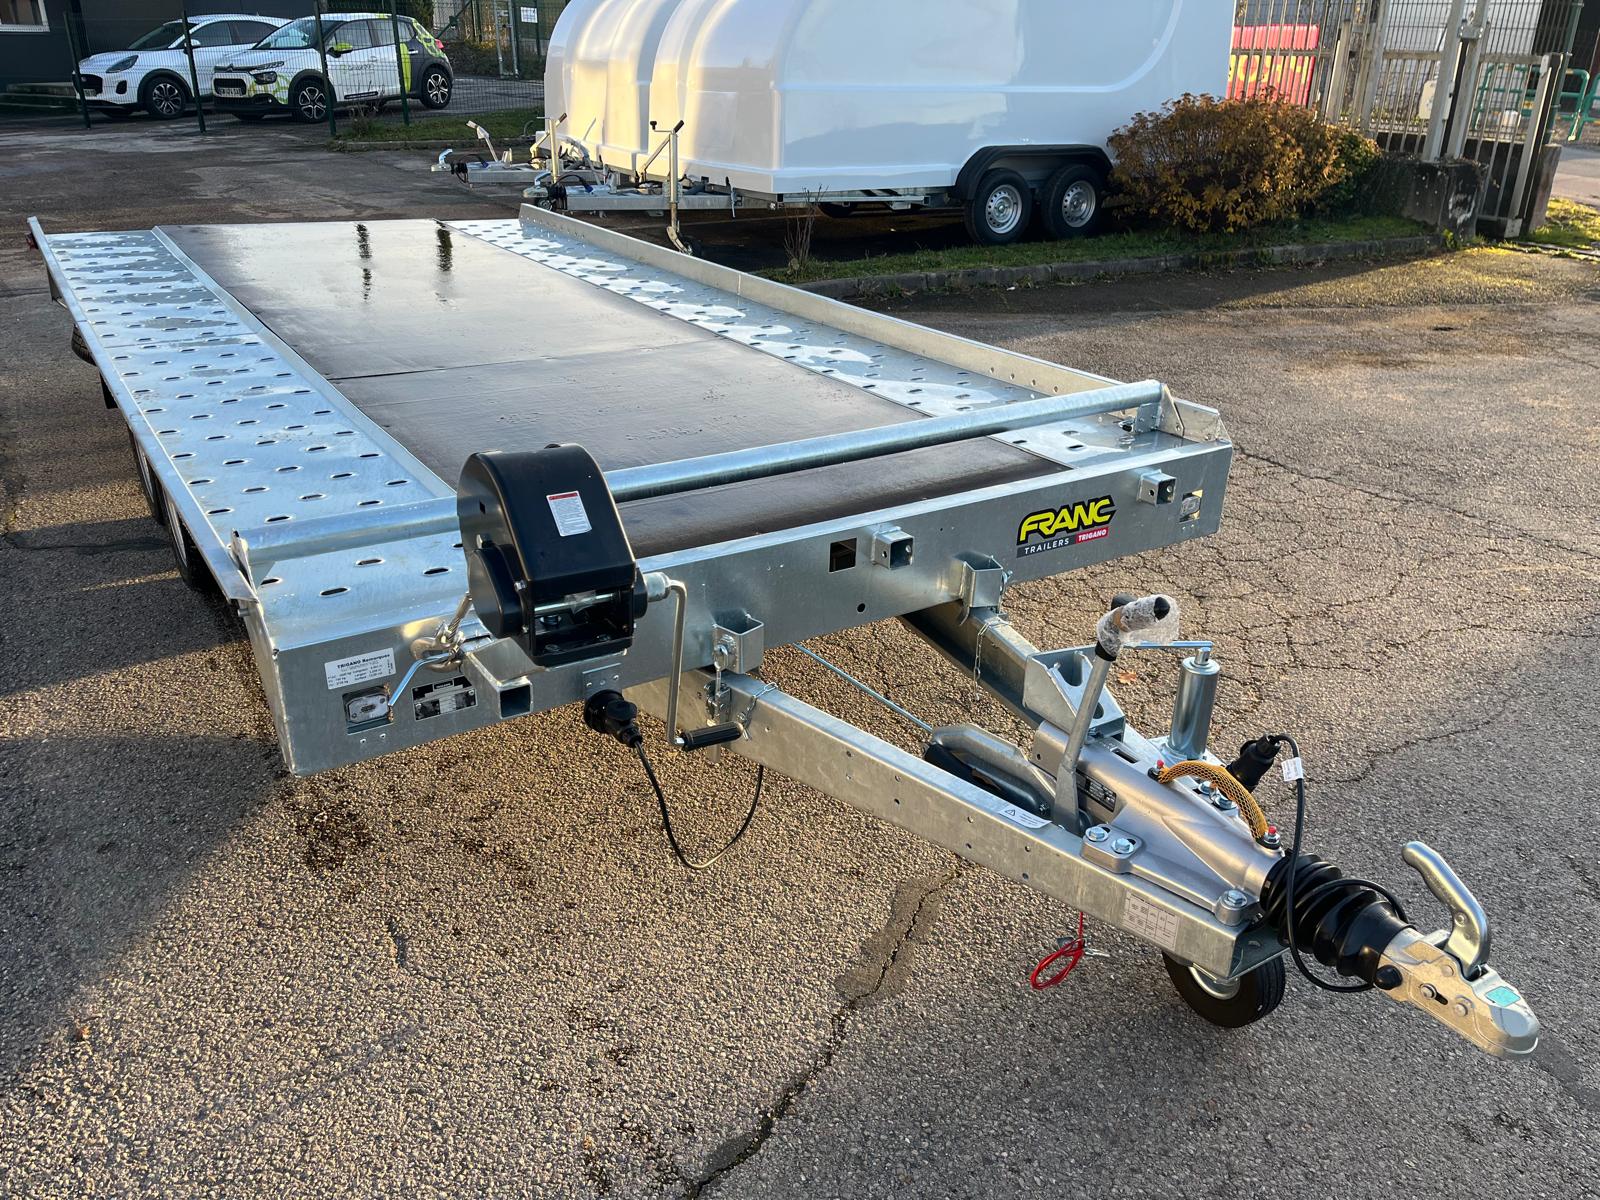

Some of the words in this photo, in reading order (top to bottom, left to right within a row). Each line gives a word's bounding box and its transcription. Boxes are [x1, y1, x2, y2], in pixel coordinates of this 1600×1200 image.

[1019, 498, 1112, 542] FRANC
[1024, 537, 1070, 556] TRAILERS
[1078, 529, 1107, 542] TRIGANO
[337, 660, 361, 669] TRIGANO
